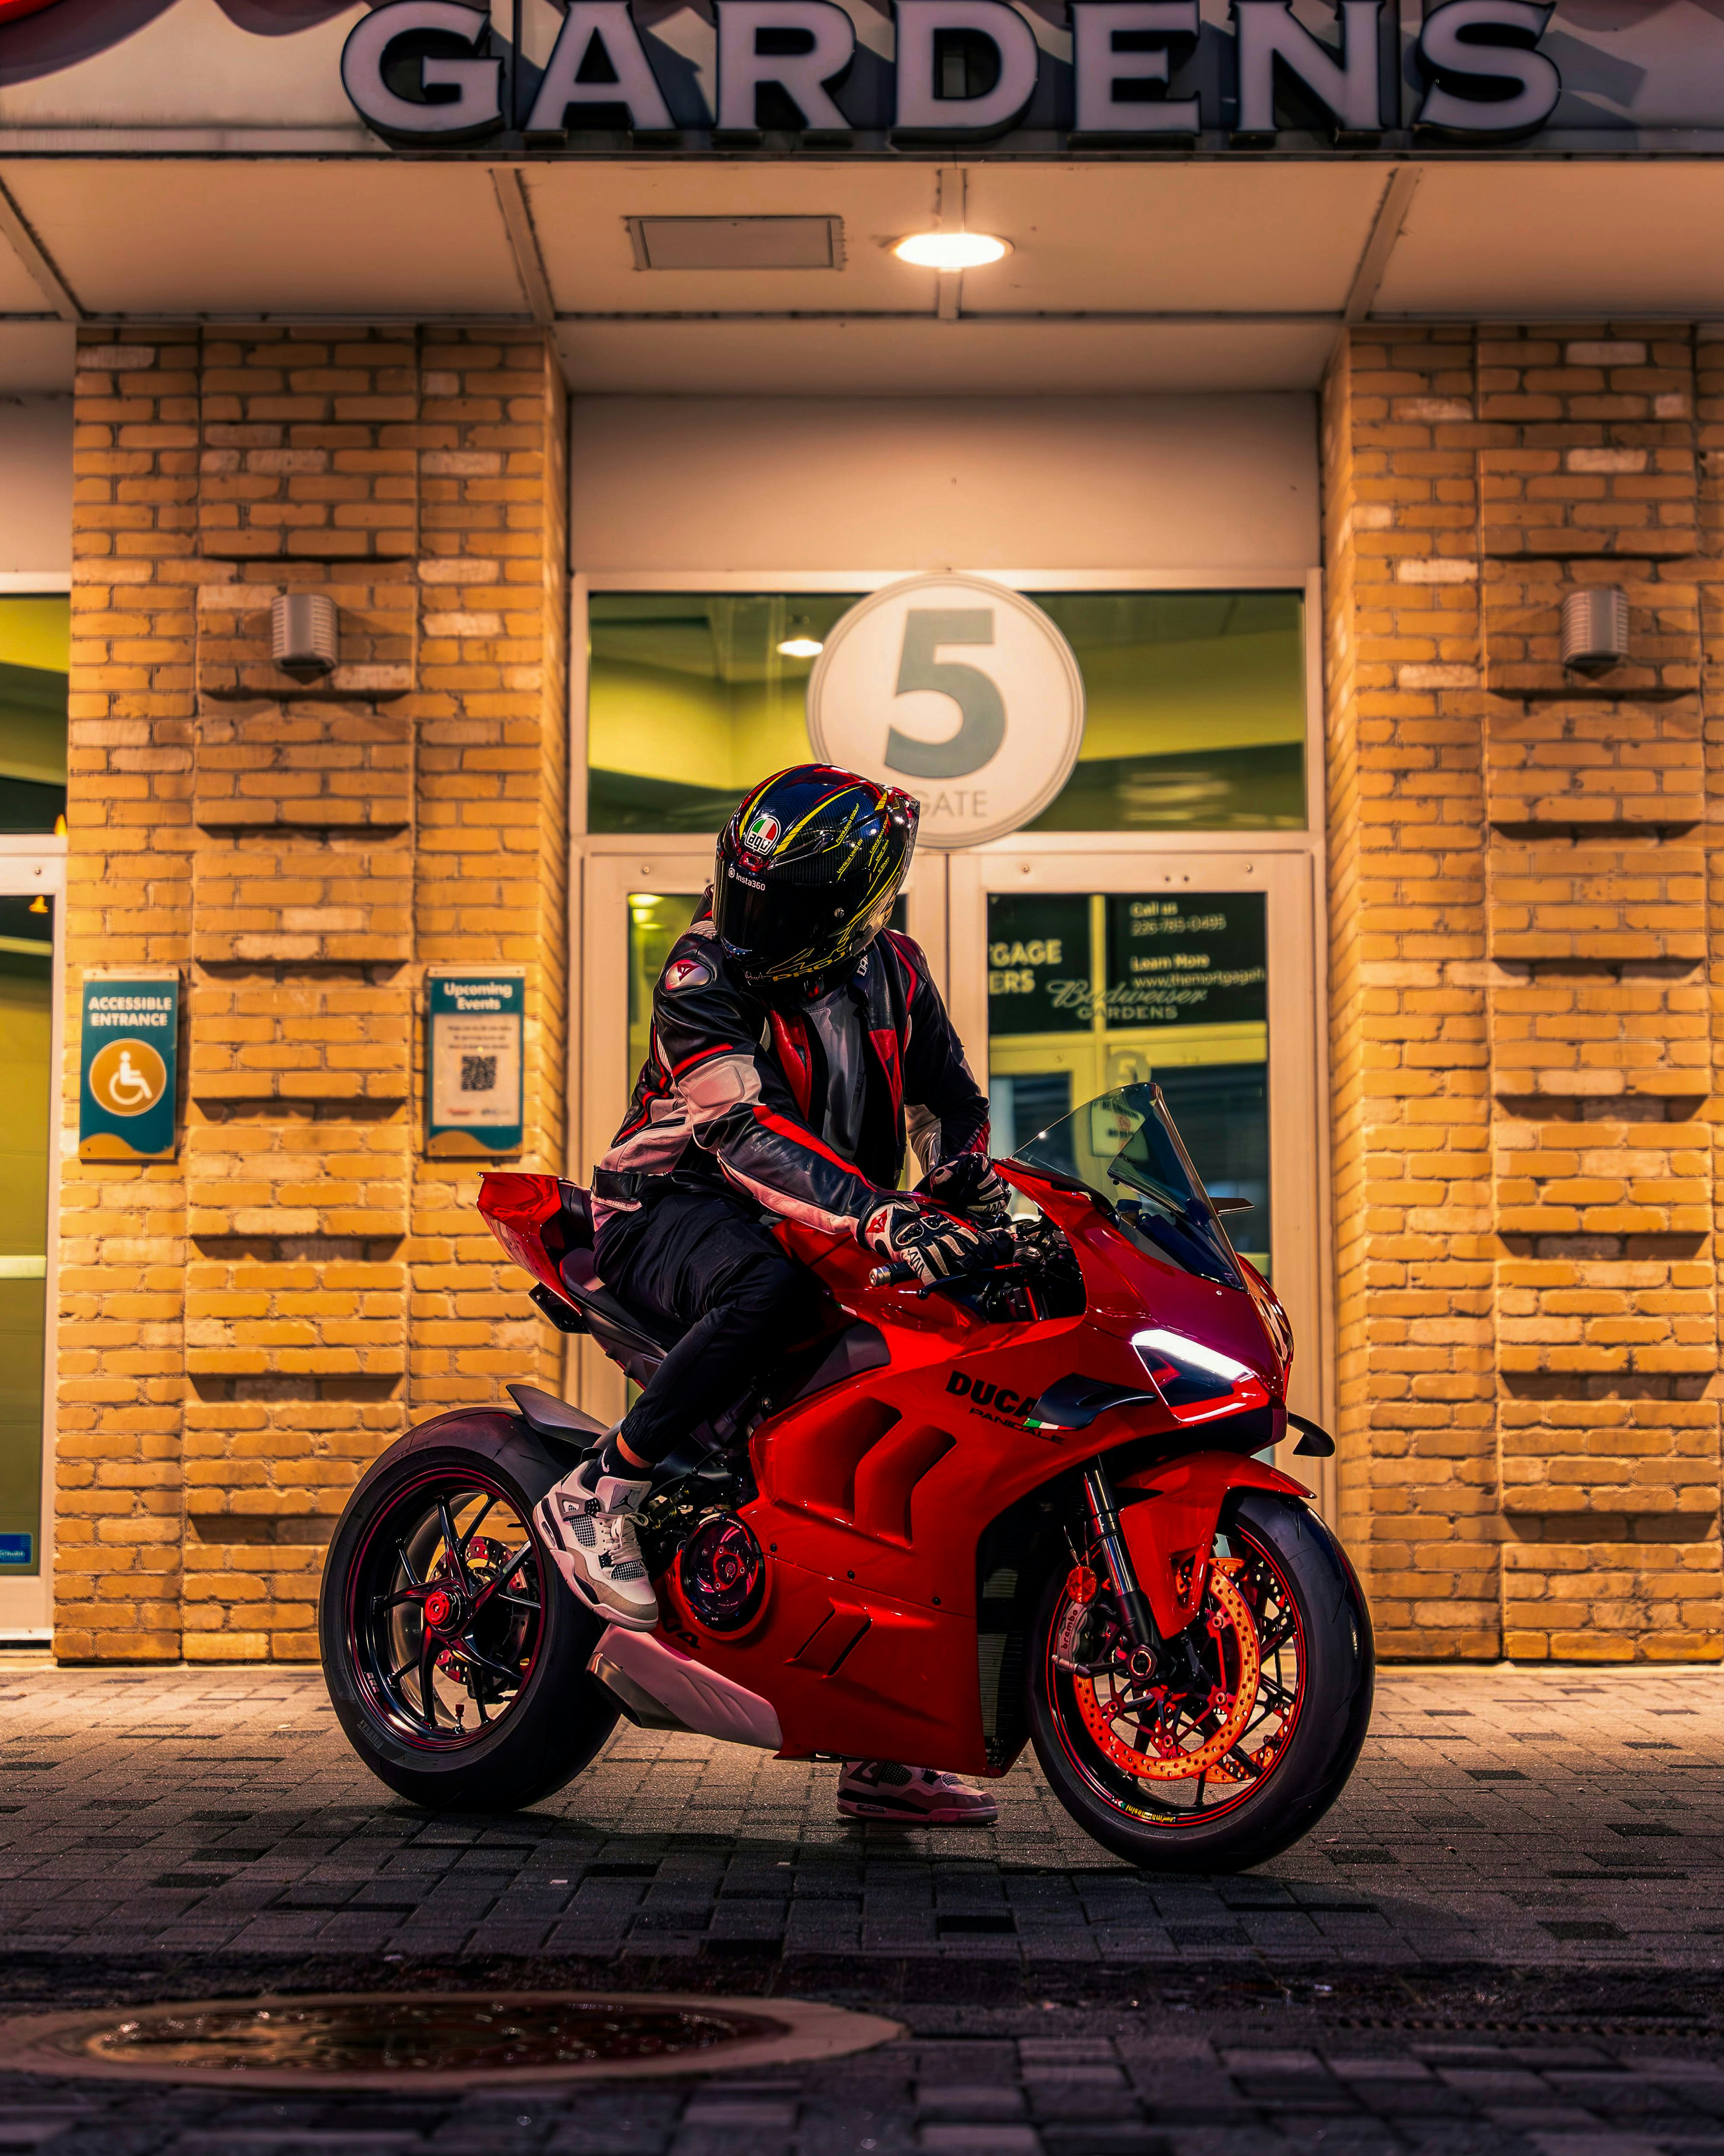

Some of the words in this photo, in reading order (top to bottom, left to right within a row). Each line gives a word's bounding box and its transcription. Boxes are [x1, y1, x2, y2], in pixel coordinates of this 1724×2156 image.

[341, 0, 1561, 138] GARDENS
[885, 609, 1008, 778] 5
[835, 829, 846, 843] Front
[844, 820, 852, 832] Area
[836, 856, 851, 874] Vertical
[736, 872, 765, 891] Insta360
[1130, 901, 1159, 918] Call
[1160, 902, 1178, 916] us
[988, 939, 1062, 967] GAGE
[1129, 955, 1171, 972] Learn
[1172, 953, 1210, 969] More
[444, 981, 513, 998] Upcoming
[1046, 979, 1208, 1009] Budweiser
[88, 996, 172, 1011] ACCESSIBLE
[457, 997, 501, 1010] Events
[1076, 1005, 1178, 1020] GARDENS
[90, 1012, 168, 1027] ENTRANCE
[1061, 1609, 1078, 1650] brembo
